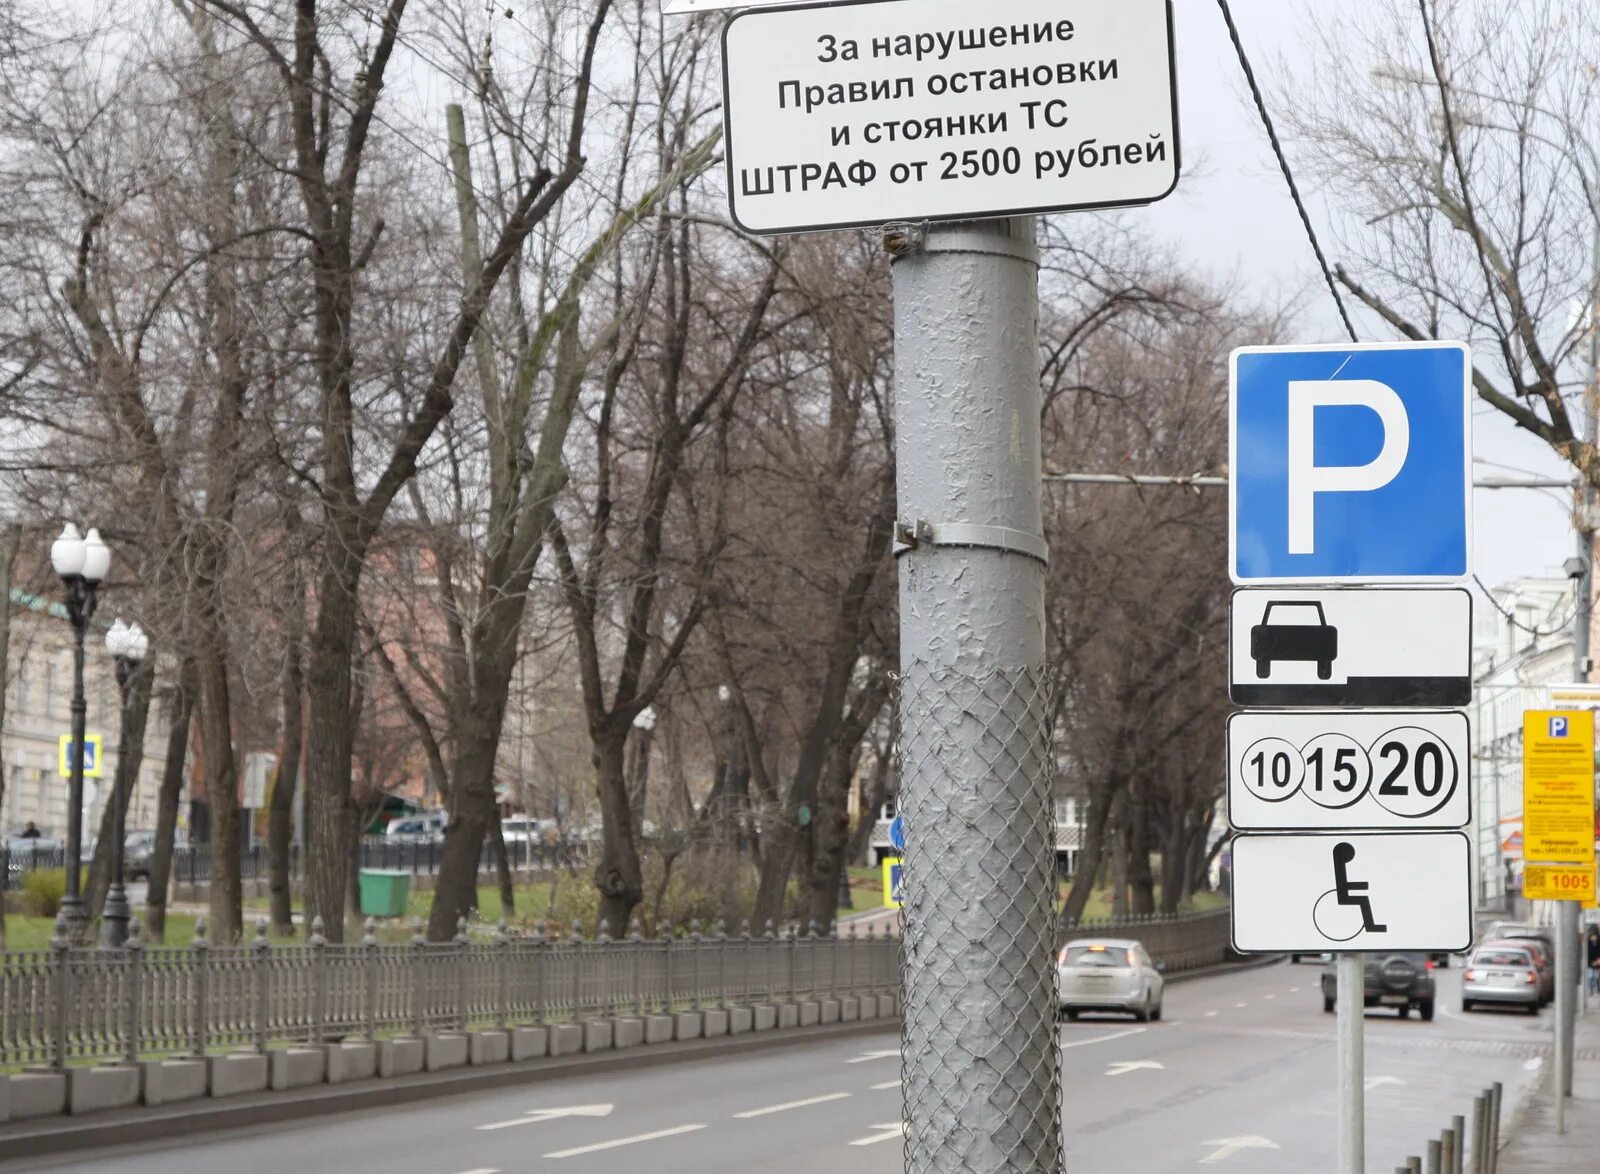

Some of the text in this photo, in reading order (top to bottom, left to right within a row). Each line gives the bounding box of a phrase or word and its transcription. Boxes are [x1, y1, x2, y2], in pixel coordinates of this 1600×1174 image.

[818, 20, 1074, 63] За нарушение
[779, 60, 1118, 114] Правил остановки
[831, 99, 1068, 147] и стоянки ТС
[741, 134, 1166, 196] ШТРАФ от 2500 рублей
[1288, 379, 1410, 555] P
[1250, 741, 1444, 797] 10 15 20
[1552, 874, 1590, 889] 1005
